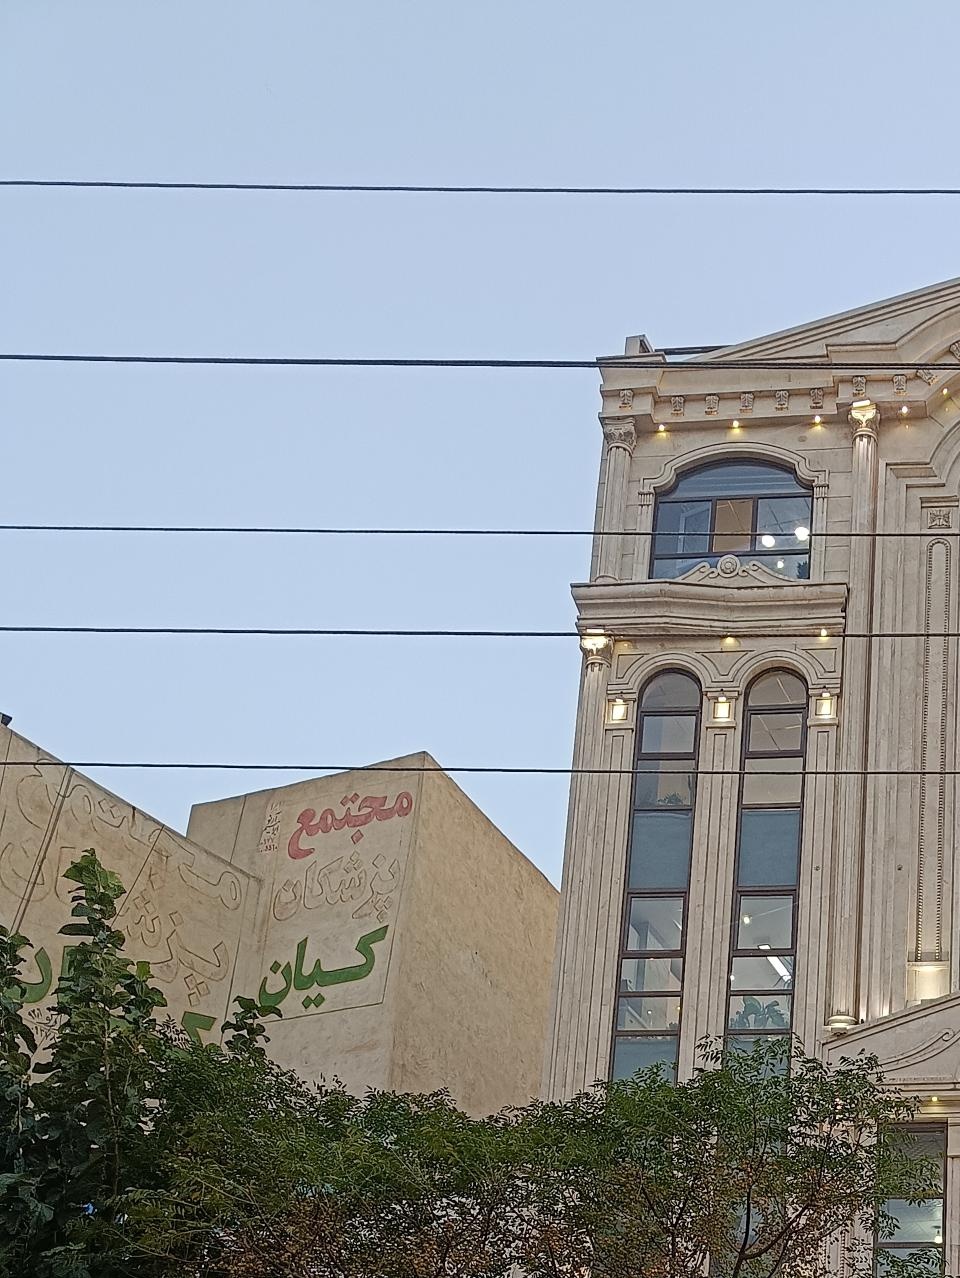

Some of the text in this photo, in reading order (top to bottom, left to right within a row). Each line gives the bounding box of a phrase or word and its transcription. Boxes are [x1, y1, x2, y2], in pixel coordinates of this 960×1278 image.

[287, 791, 413, 860] مجتمع
[273, 850, 401, 923] پزشکان
[258, 924, 389, 1009] کیان
